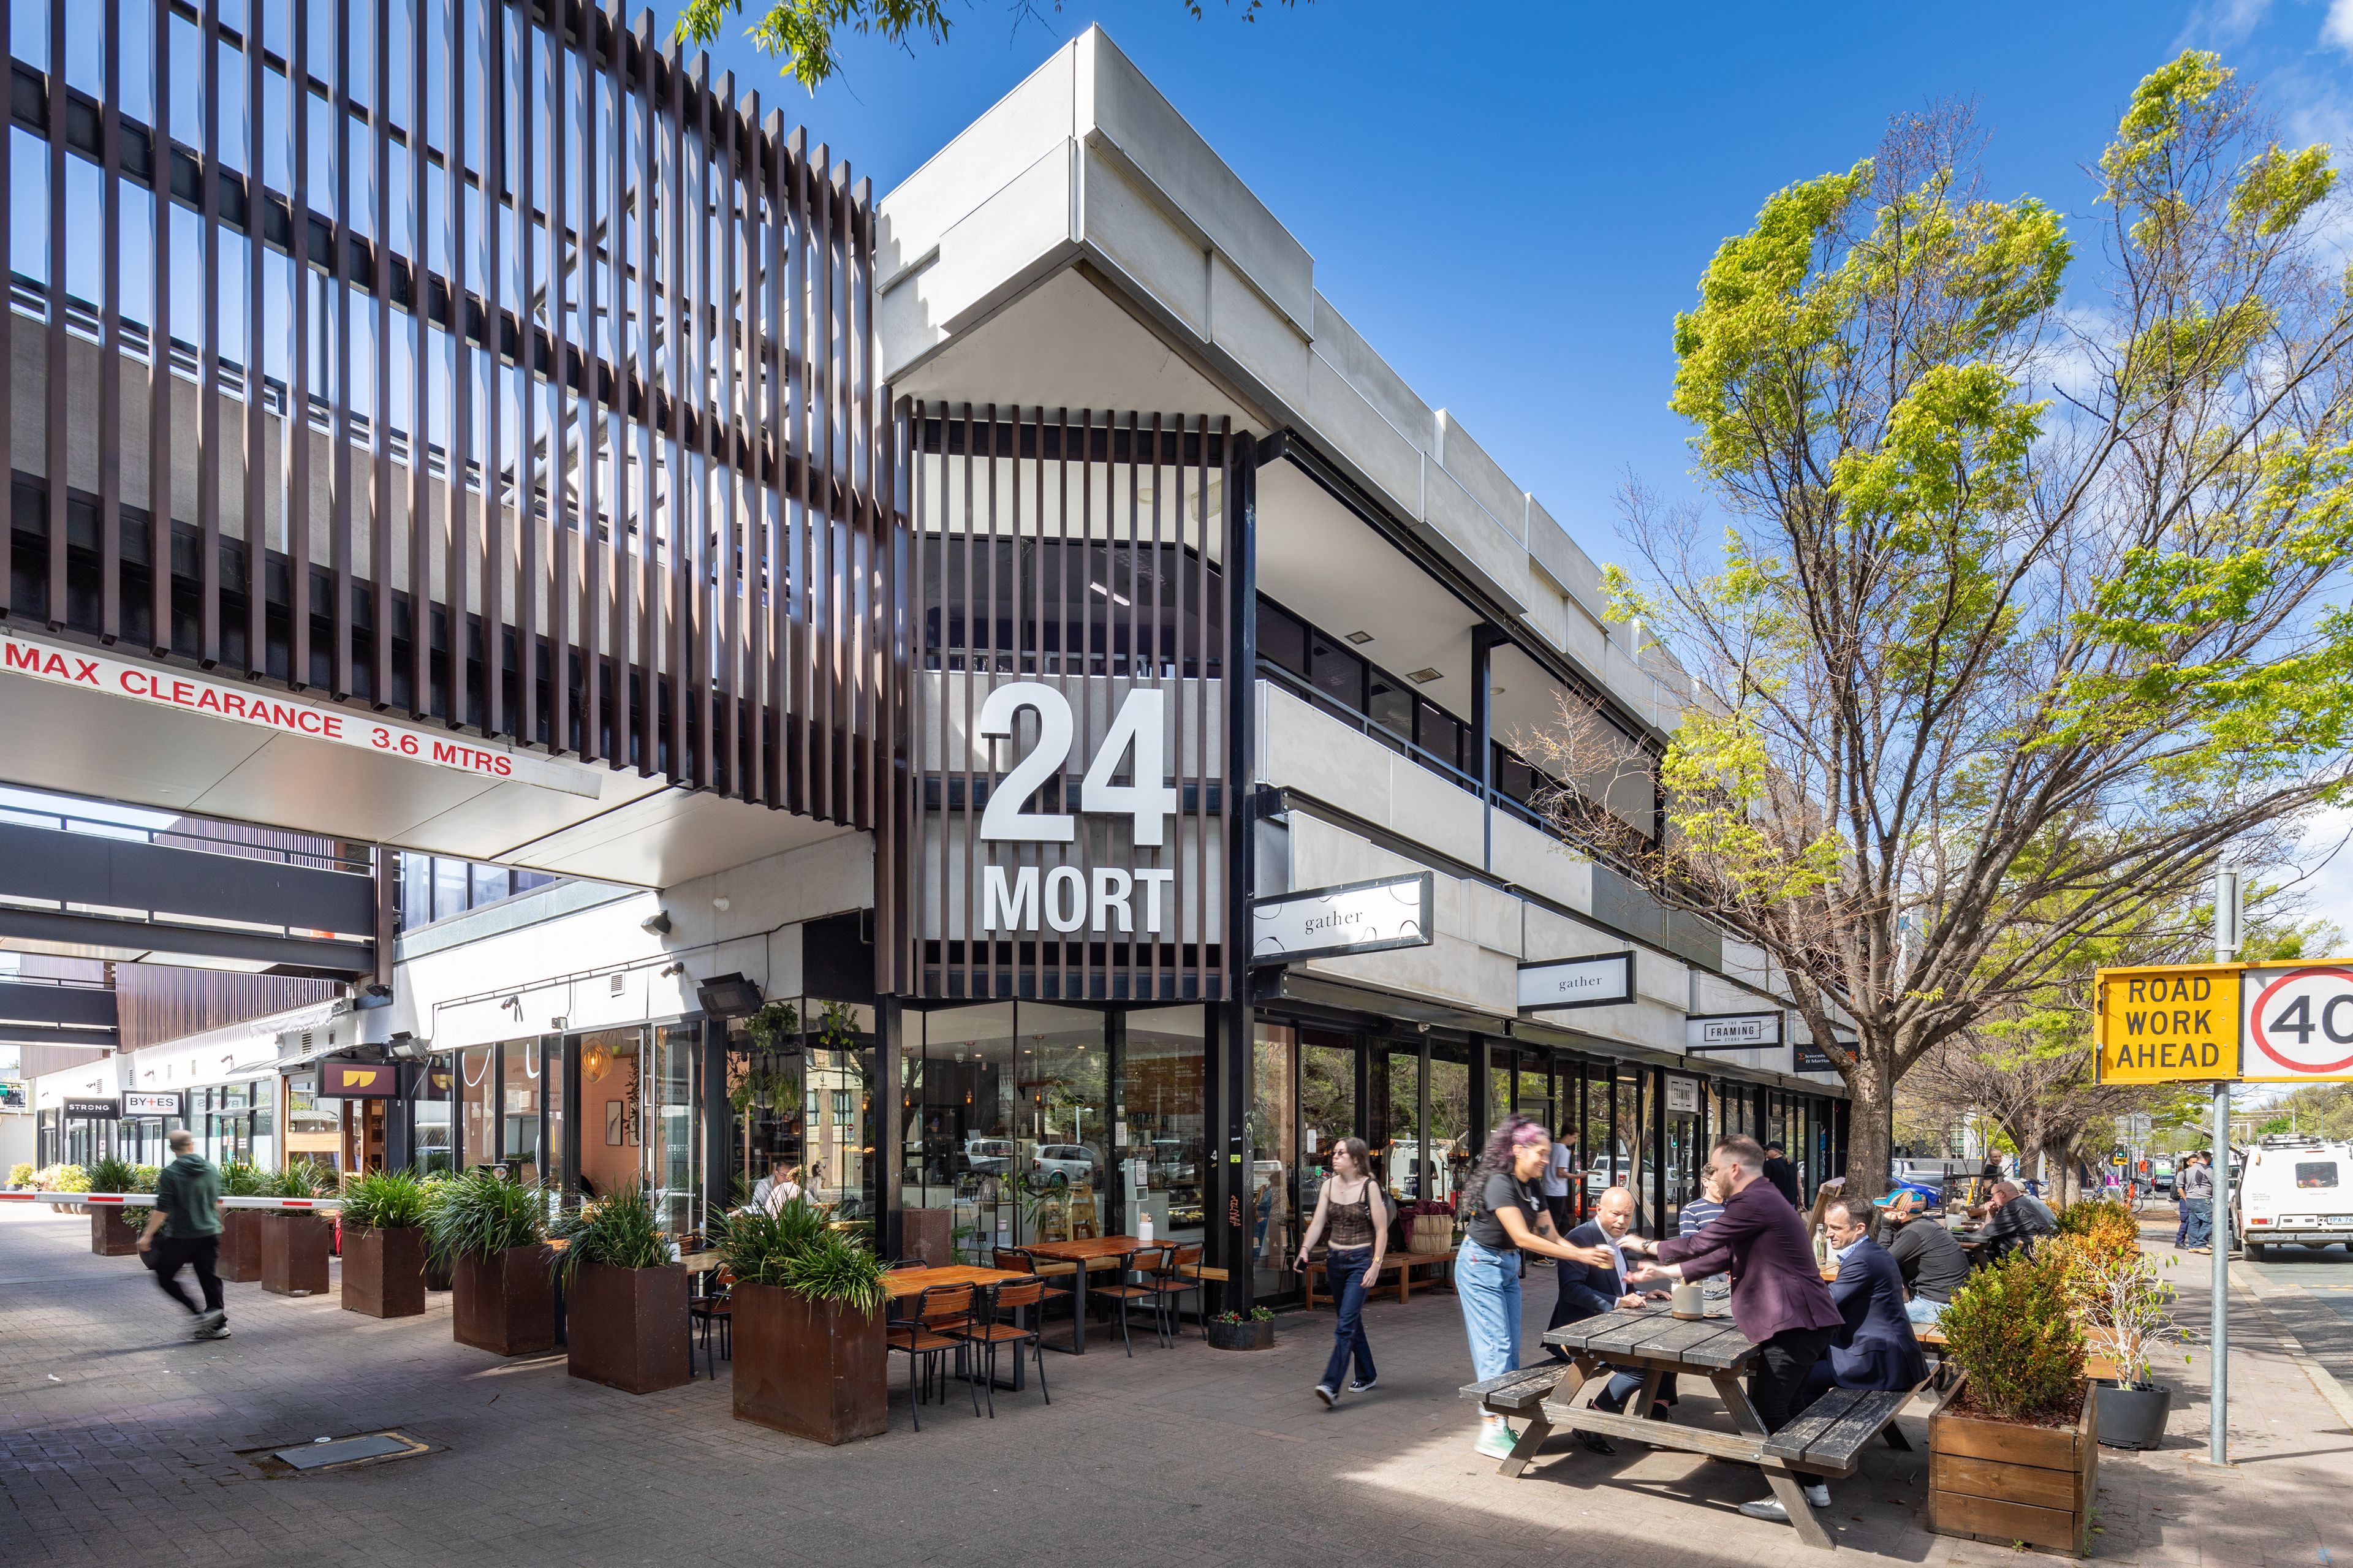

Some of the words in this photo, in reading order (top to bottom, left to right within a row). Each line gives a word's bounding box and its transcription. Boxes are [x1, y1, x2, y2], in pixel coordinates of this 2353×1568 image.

[5, 642, 101, 686] MAX
[119, 670, 343, 740] CLEARANCE
[371, 727, 419, 755] 3.6
[433, 741, 512, 776] MTRS
[980, 682, 1176, 846] 24
[983, 865, 1173, 933] MORT
[1305, 911, 1363, 934] gather
[1559, 975, 1603, 992] gather
[2129, 976, 2211, 1003] ROAD
[1711, 1026, 1754, 1037] FRAMING
[2125, 1009, 2212, 1036] WORK
[2269, 994, 2353, 1044] 40
[2116, 1042, 2219, 1068] AHEAD
